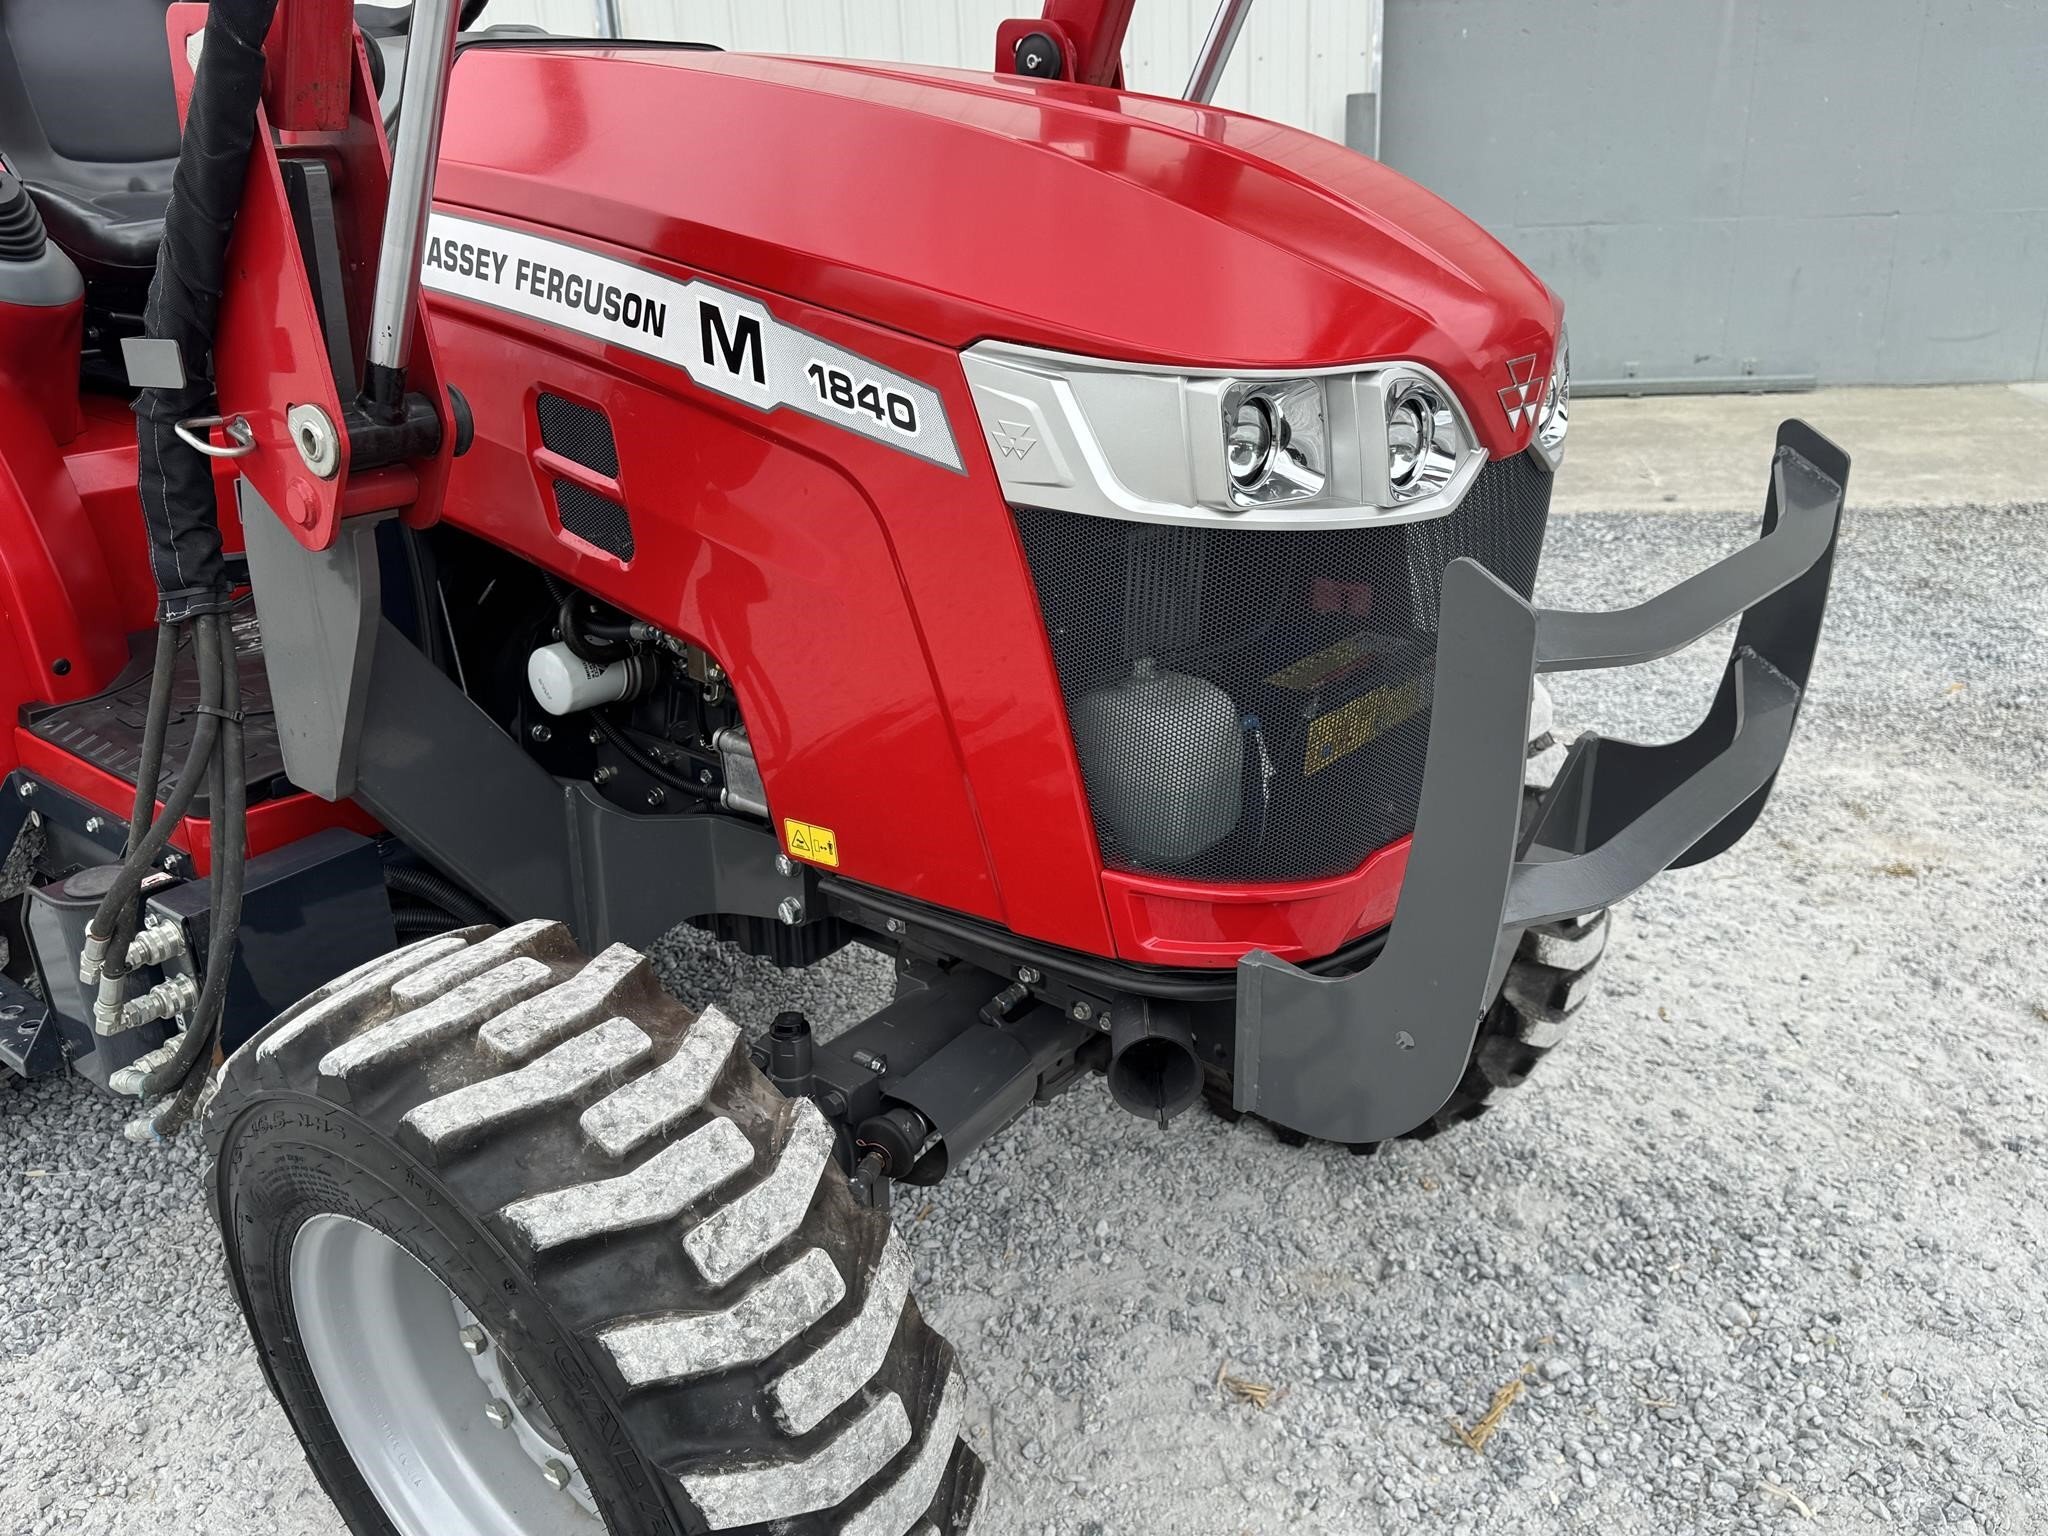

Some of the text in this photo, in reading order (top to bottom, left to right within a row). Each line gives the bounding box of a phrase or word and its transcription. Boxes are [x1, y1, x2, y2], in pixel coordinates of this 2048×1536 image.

[422, 236, 917, 432] ASSEY FERGUSON M 1840
